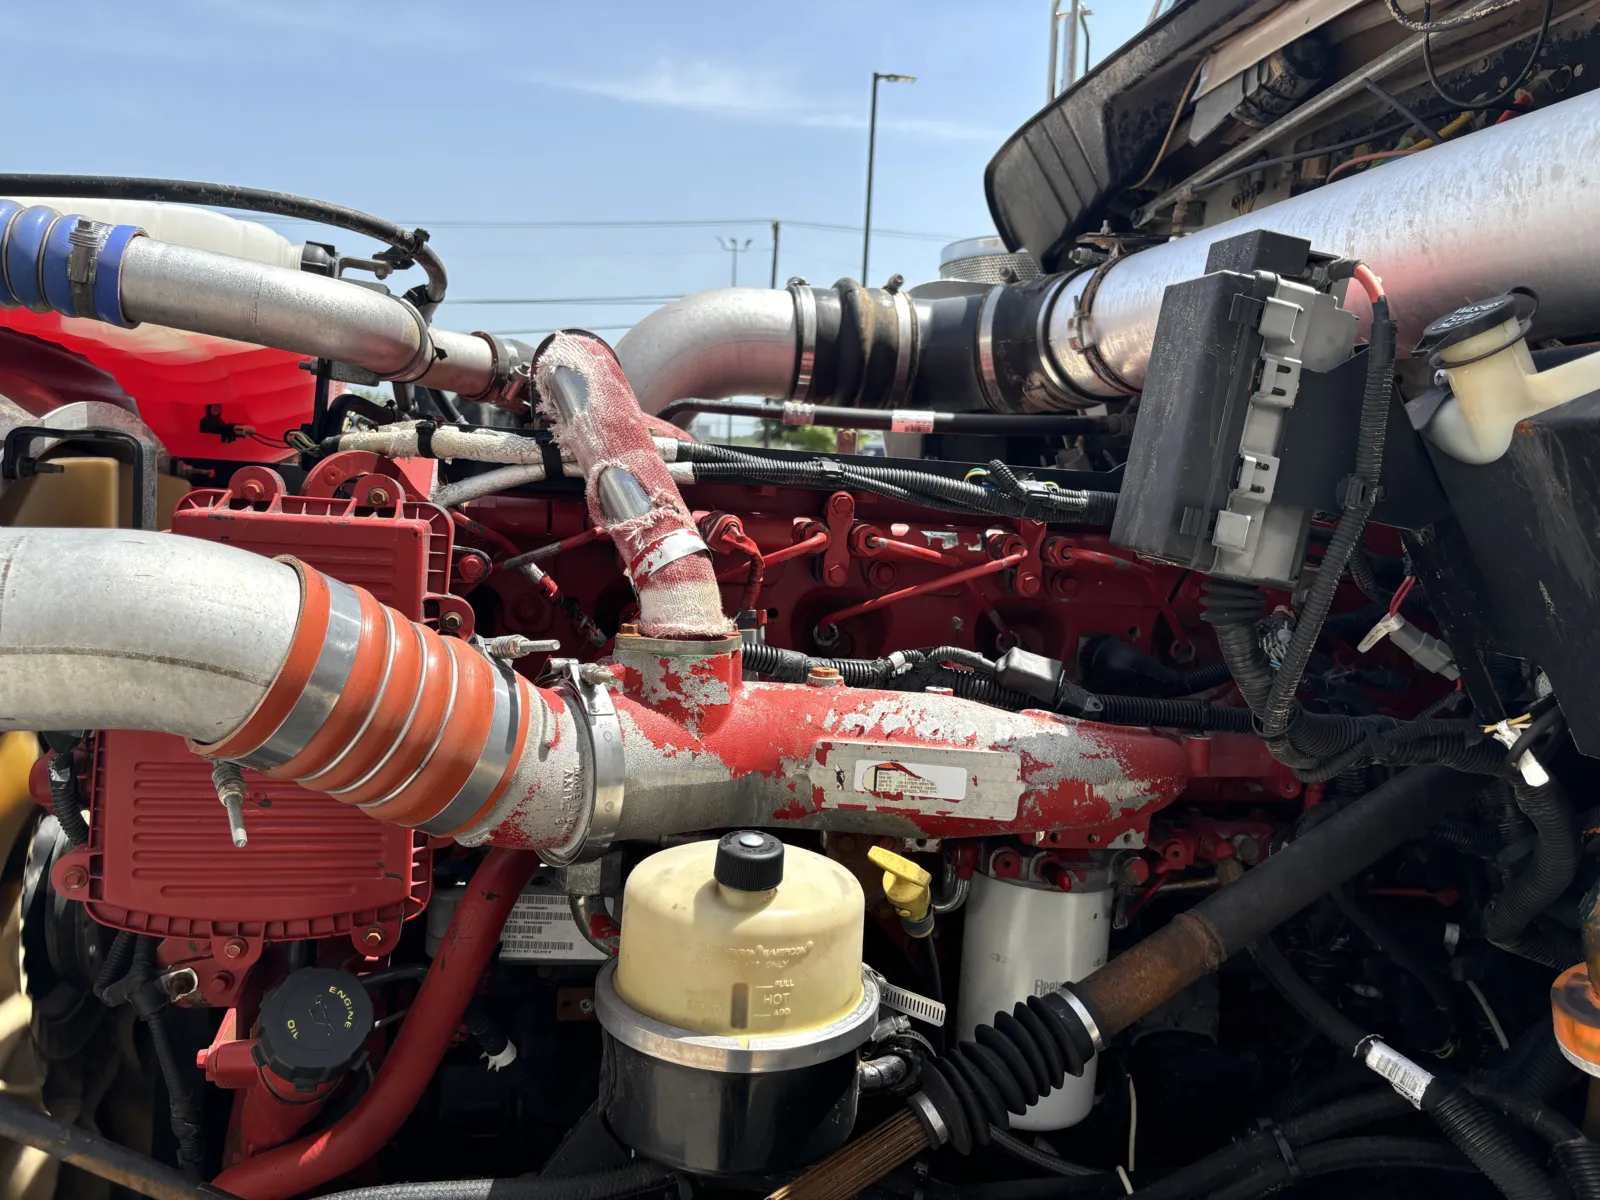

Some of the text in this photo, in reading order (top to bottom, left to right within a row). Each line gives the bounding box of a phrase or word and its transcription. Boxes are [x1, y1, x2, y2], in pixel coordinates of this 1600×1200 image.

[766, 959, 789, 969] ONLY
[774, 978, 795, 987] FULL
[763, 992, 790, 1005] HOT
[328, 985, 354, 1029] ENGINE
[773, 1007, 791, 1016] ADD
[287, 1019, 299, 1040] OIL
